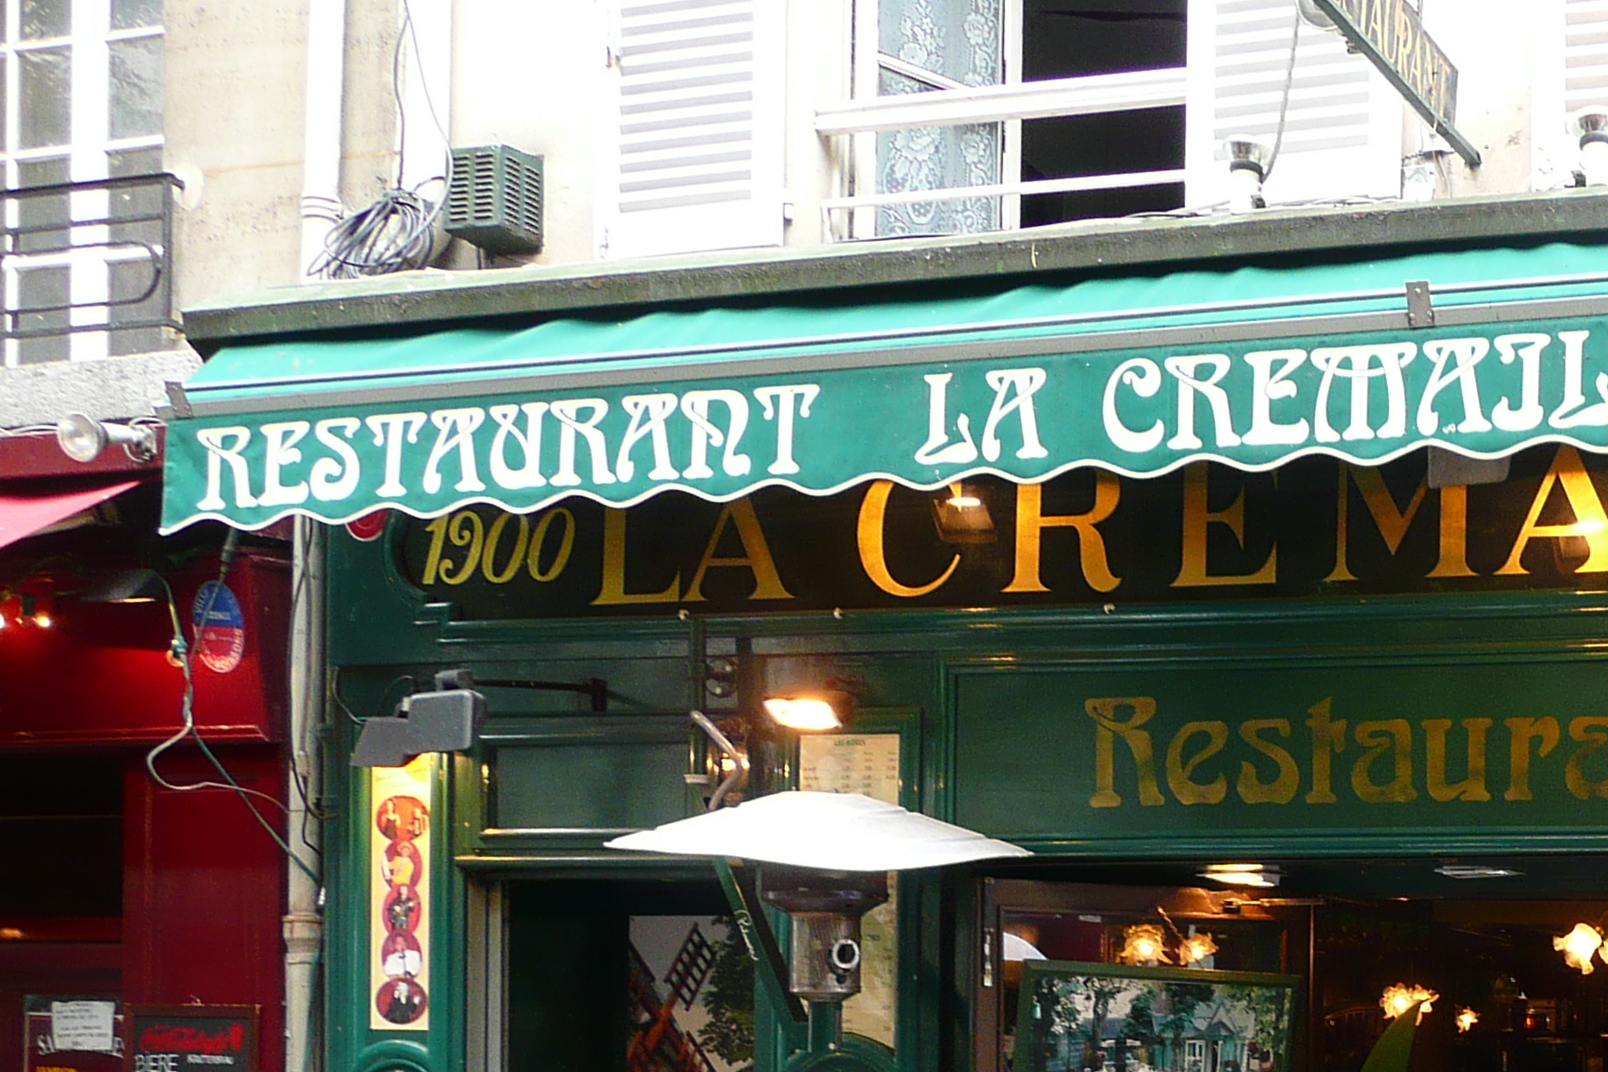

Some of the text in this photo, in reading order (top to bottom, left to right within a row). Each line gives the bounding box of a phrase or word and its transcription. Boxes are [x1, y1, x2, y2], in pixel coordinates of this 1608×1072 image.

[196, 384, 820, 510] RESTAURANT
[914, 367, 1049, 465] LA
[421, 506, 576, 587] 1900
[590, 498, 796, 607] LA
